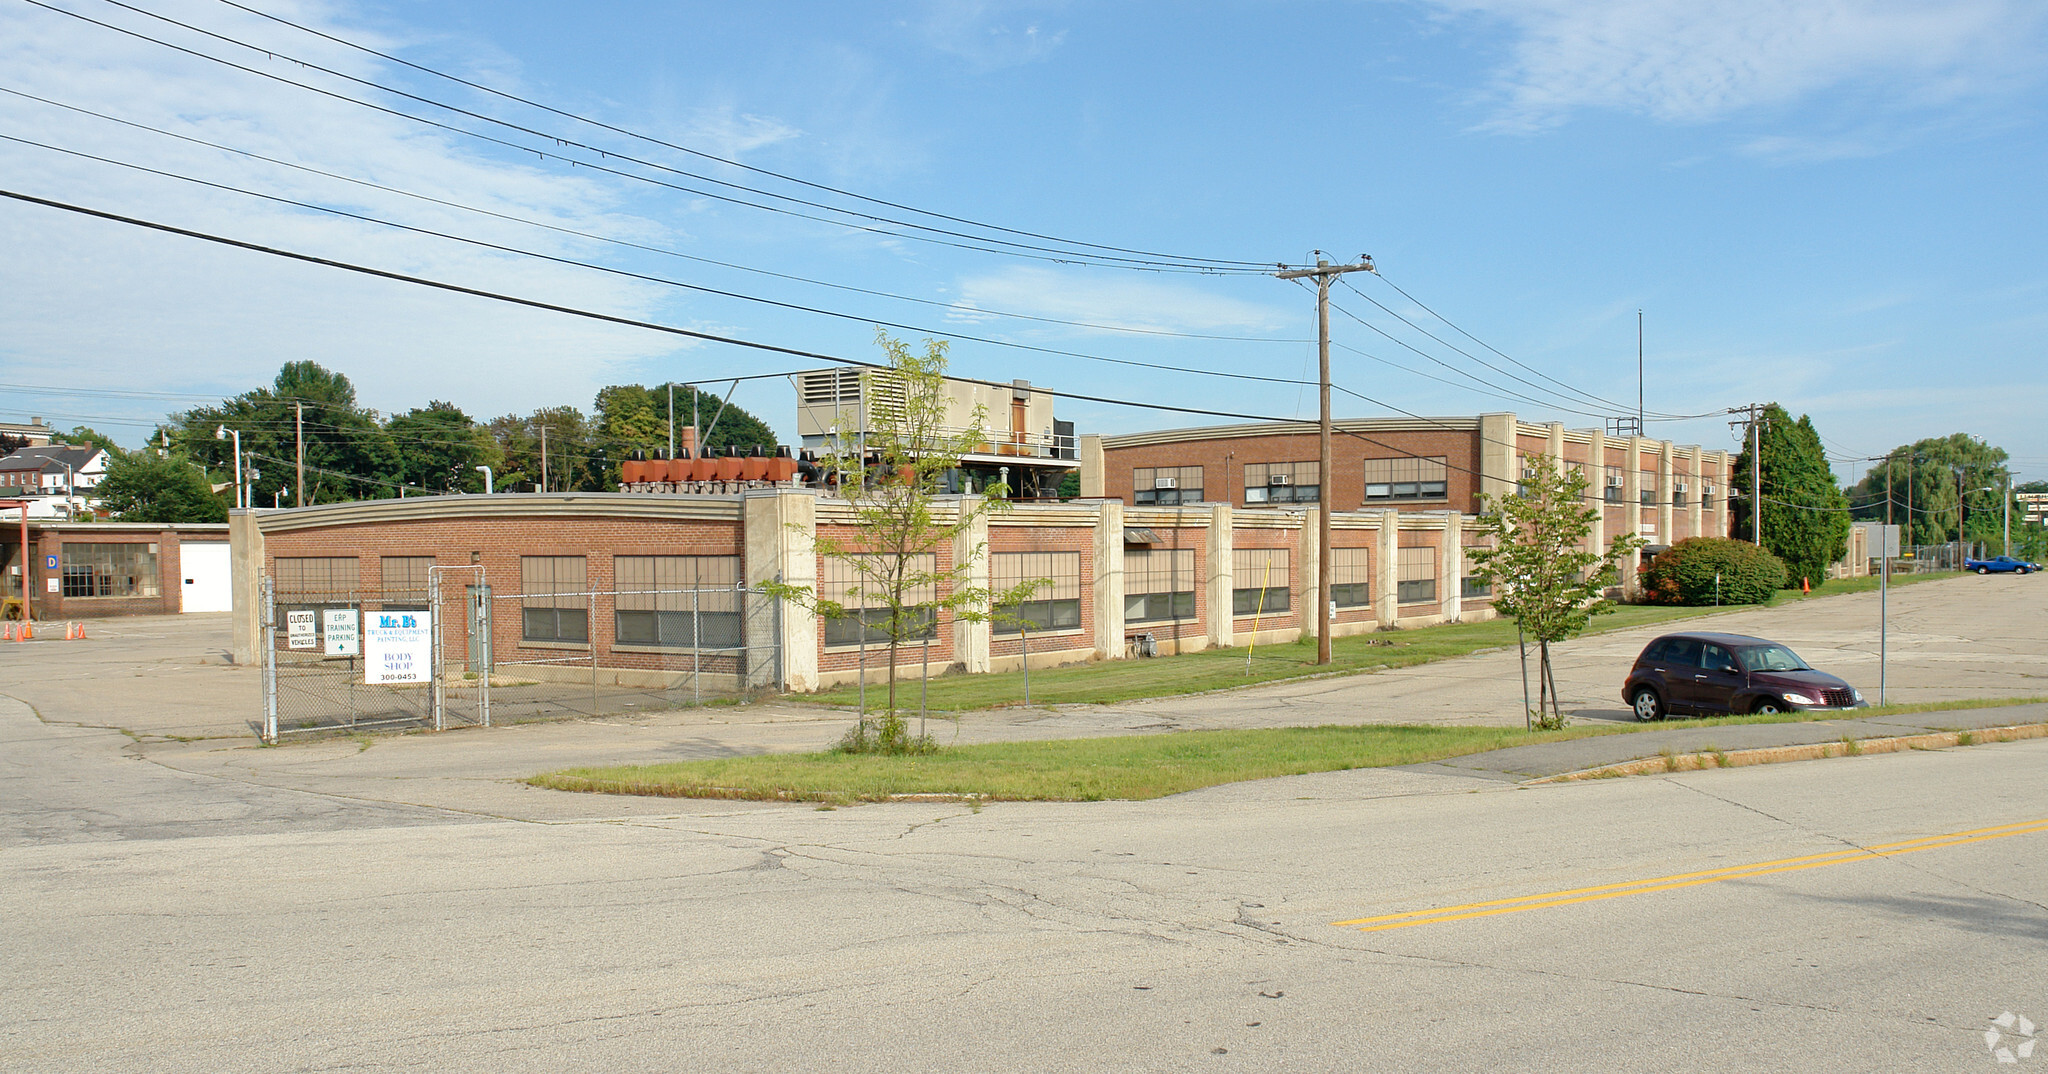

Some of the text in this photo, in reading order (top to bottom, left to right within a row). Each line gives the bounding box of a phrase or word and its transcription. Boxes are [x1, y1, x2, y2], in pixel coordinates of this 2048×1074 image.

[48, 557, 56, 567] D
[290, 614, 313, 623] CLOSED
[379, 615, 417, 628] Mr. B's
[384, 662, 413, 670] SHOP
[381, 673, 417, 681] 300-0453
